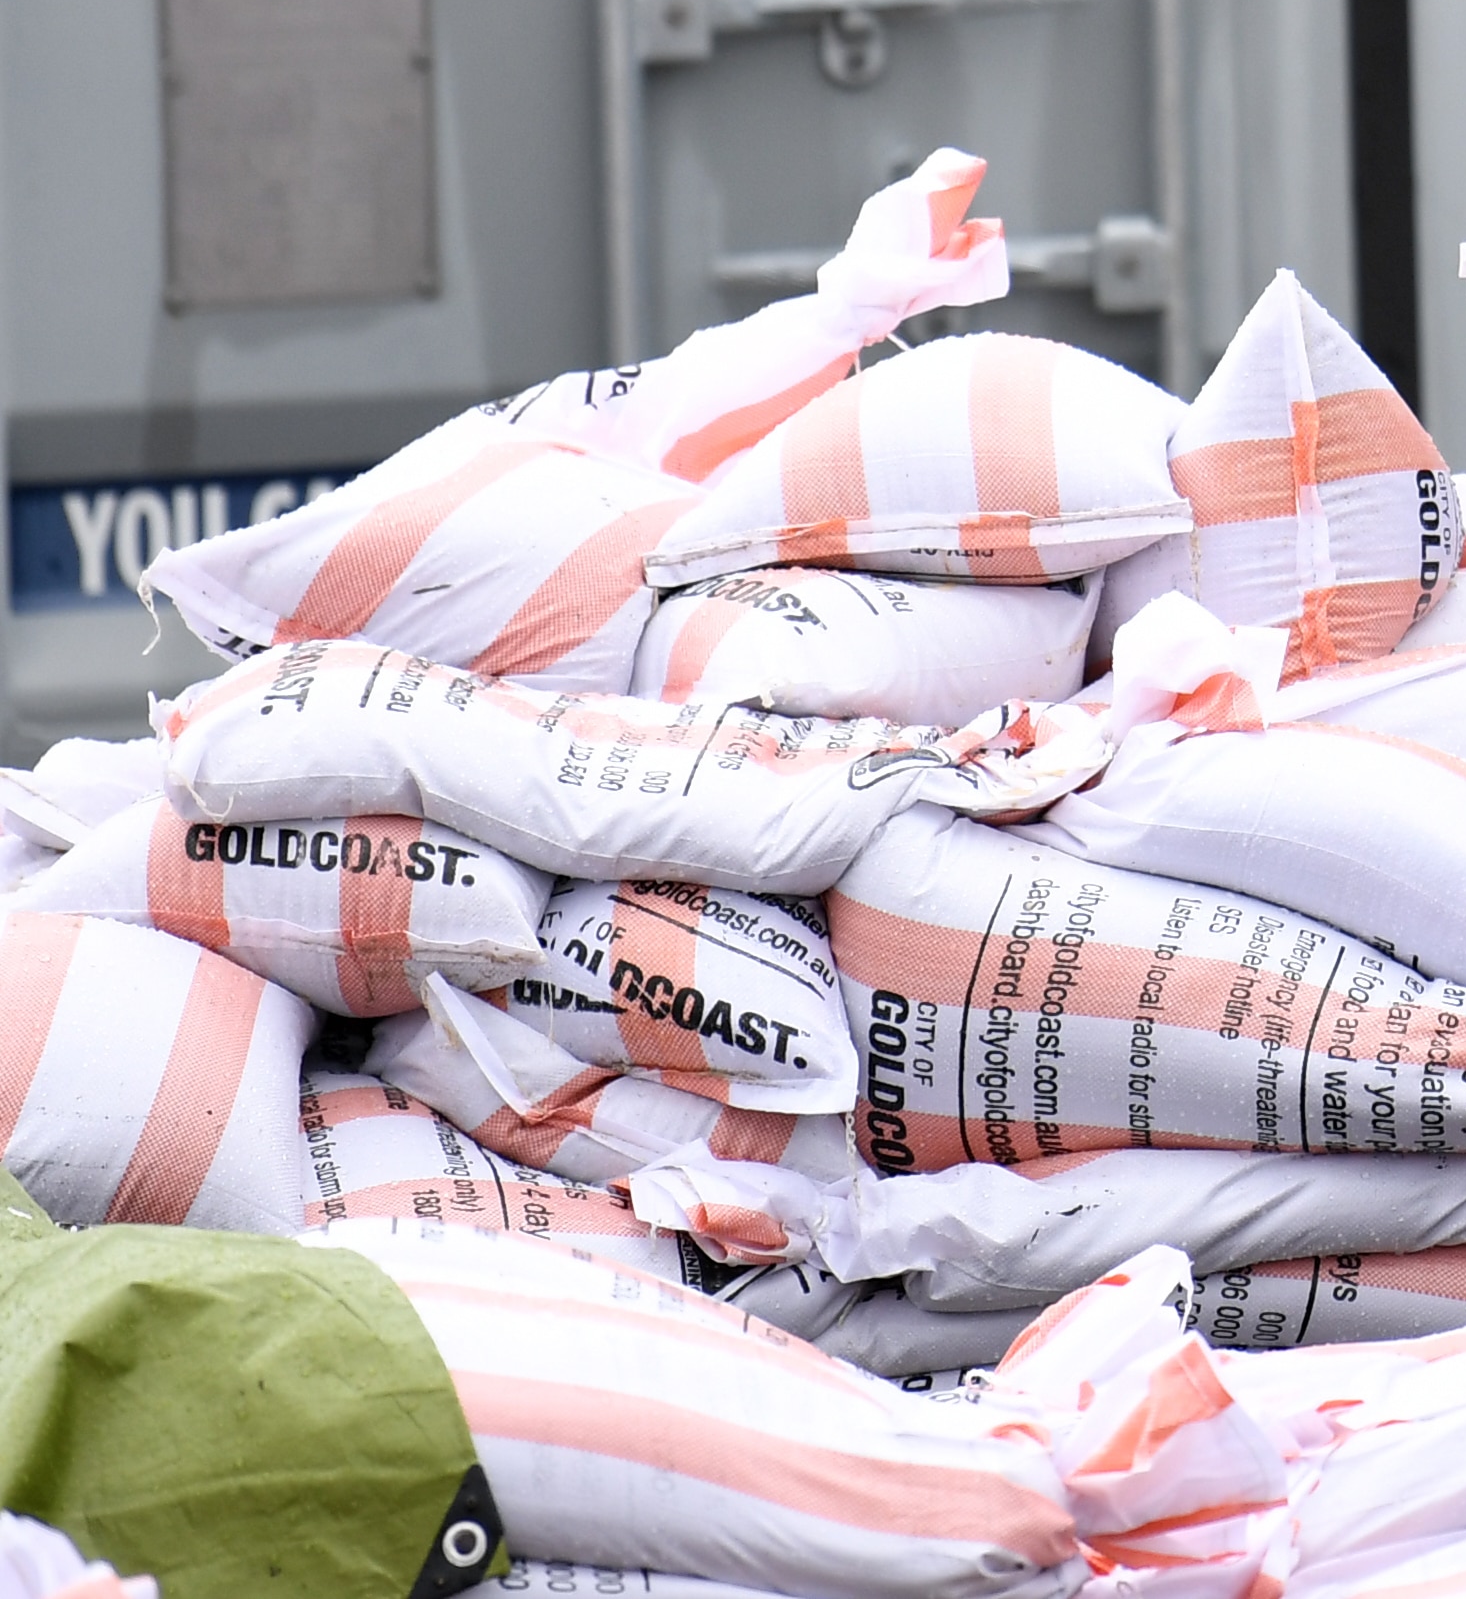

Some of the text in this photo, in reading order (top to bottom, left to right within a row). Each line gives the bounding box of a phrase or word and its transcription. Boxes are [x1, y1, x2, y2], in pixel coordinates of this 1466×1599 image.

[184, 822, 480, 888] GOLDCOAST.
[596, 921, 628, 945] OF
[1160, 896, 1203, 942] Listen
[1208, 903, 1244, 937] SES
[1153, 942, 1184, 963] to
[1266, 927, 1327, 1013] Emergency
[1136, 962, 1176, 1012] local
[1218, 913, 1286, 1042] Disaster hotline
[1341, 971, 1385, 1014] food
[911, 1000, 939, 1089] CITY OF
[1129, 1014, 1160, 1069] radio
[1327, 1015, 1360, 1064] and
[1374, 1040, 1410, 1079] for
[1127, 1069, 1157, 1101] for
[1321, 1068, 1356, 1139] water
[1364, 1082, 1397, 1140] your
[313, 1159, 345, 1199] storm
[449, 1177, 487, 1213] only)
[1328, 1252, 1364, 1304] ays
[1210, 1304, 1246, 1342] 000
[1252, 1310, 1287, 1343] 000
